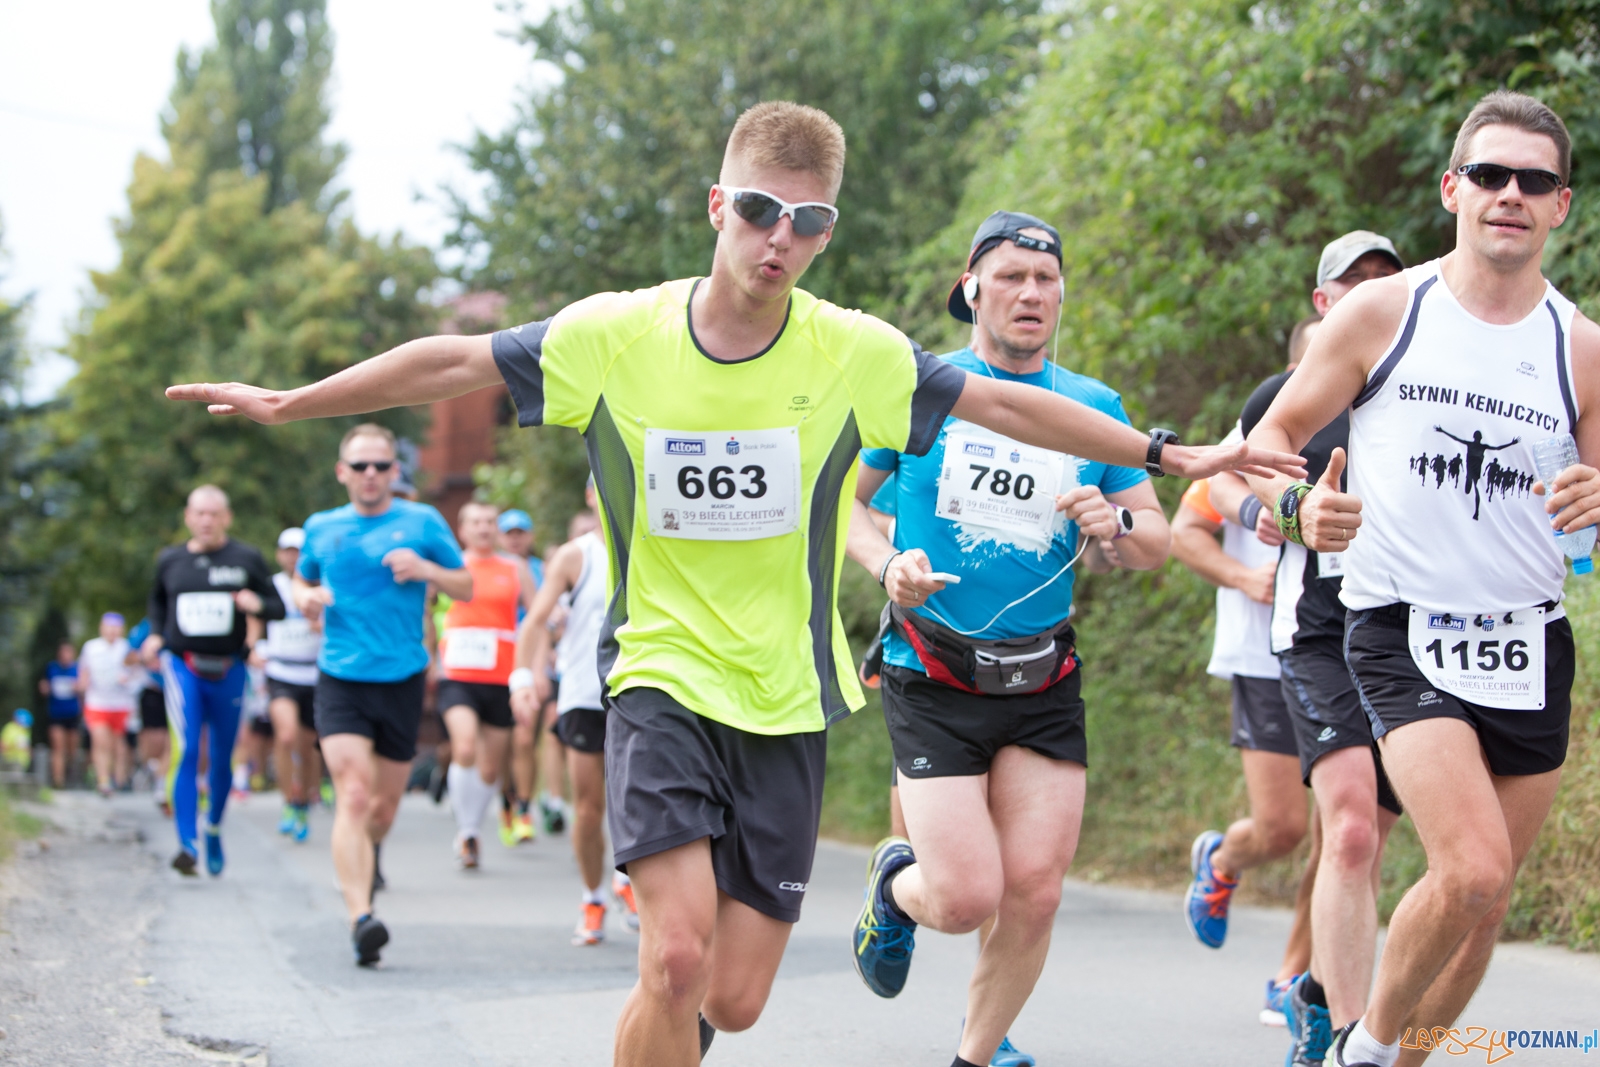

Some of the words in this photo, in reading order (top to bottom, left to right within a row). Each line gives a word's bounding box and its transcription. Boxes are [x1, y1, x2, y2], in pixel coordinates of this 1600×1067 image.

[1399, 384, 1459, 405] SŁYNNI
[1465, 392, 1560, 433] KENIJCZYCY
[678, 465, 767, 499] 663
[969, 464, 1035, 500] 780
[682, 510, 696, 520] 39
[699, 510, 726, 520] BIEG
[730, 507, 786, 520] LECHITÓW
[966, 499, 977, 508] 39
[979, 502, 999, 512] BIEG
[1000, 506, 1043, 520] LECHITÓW
[1425, 638, 1529, 672] 1156
[1459, 681, 1480, 689] BIEG
[1483, 680, 1531, 691] LECHITÓW
